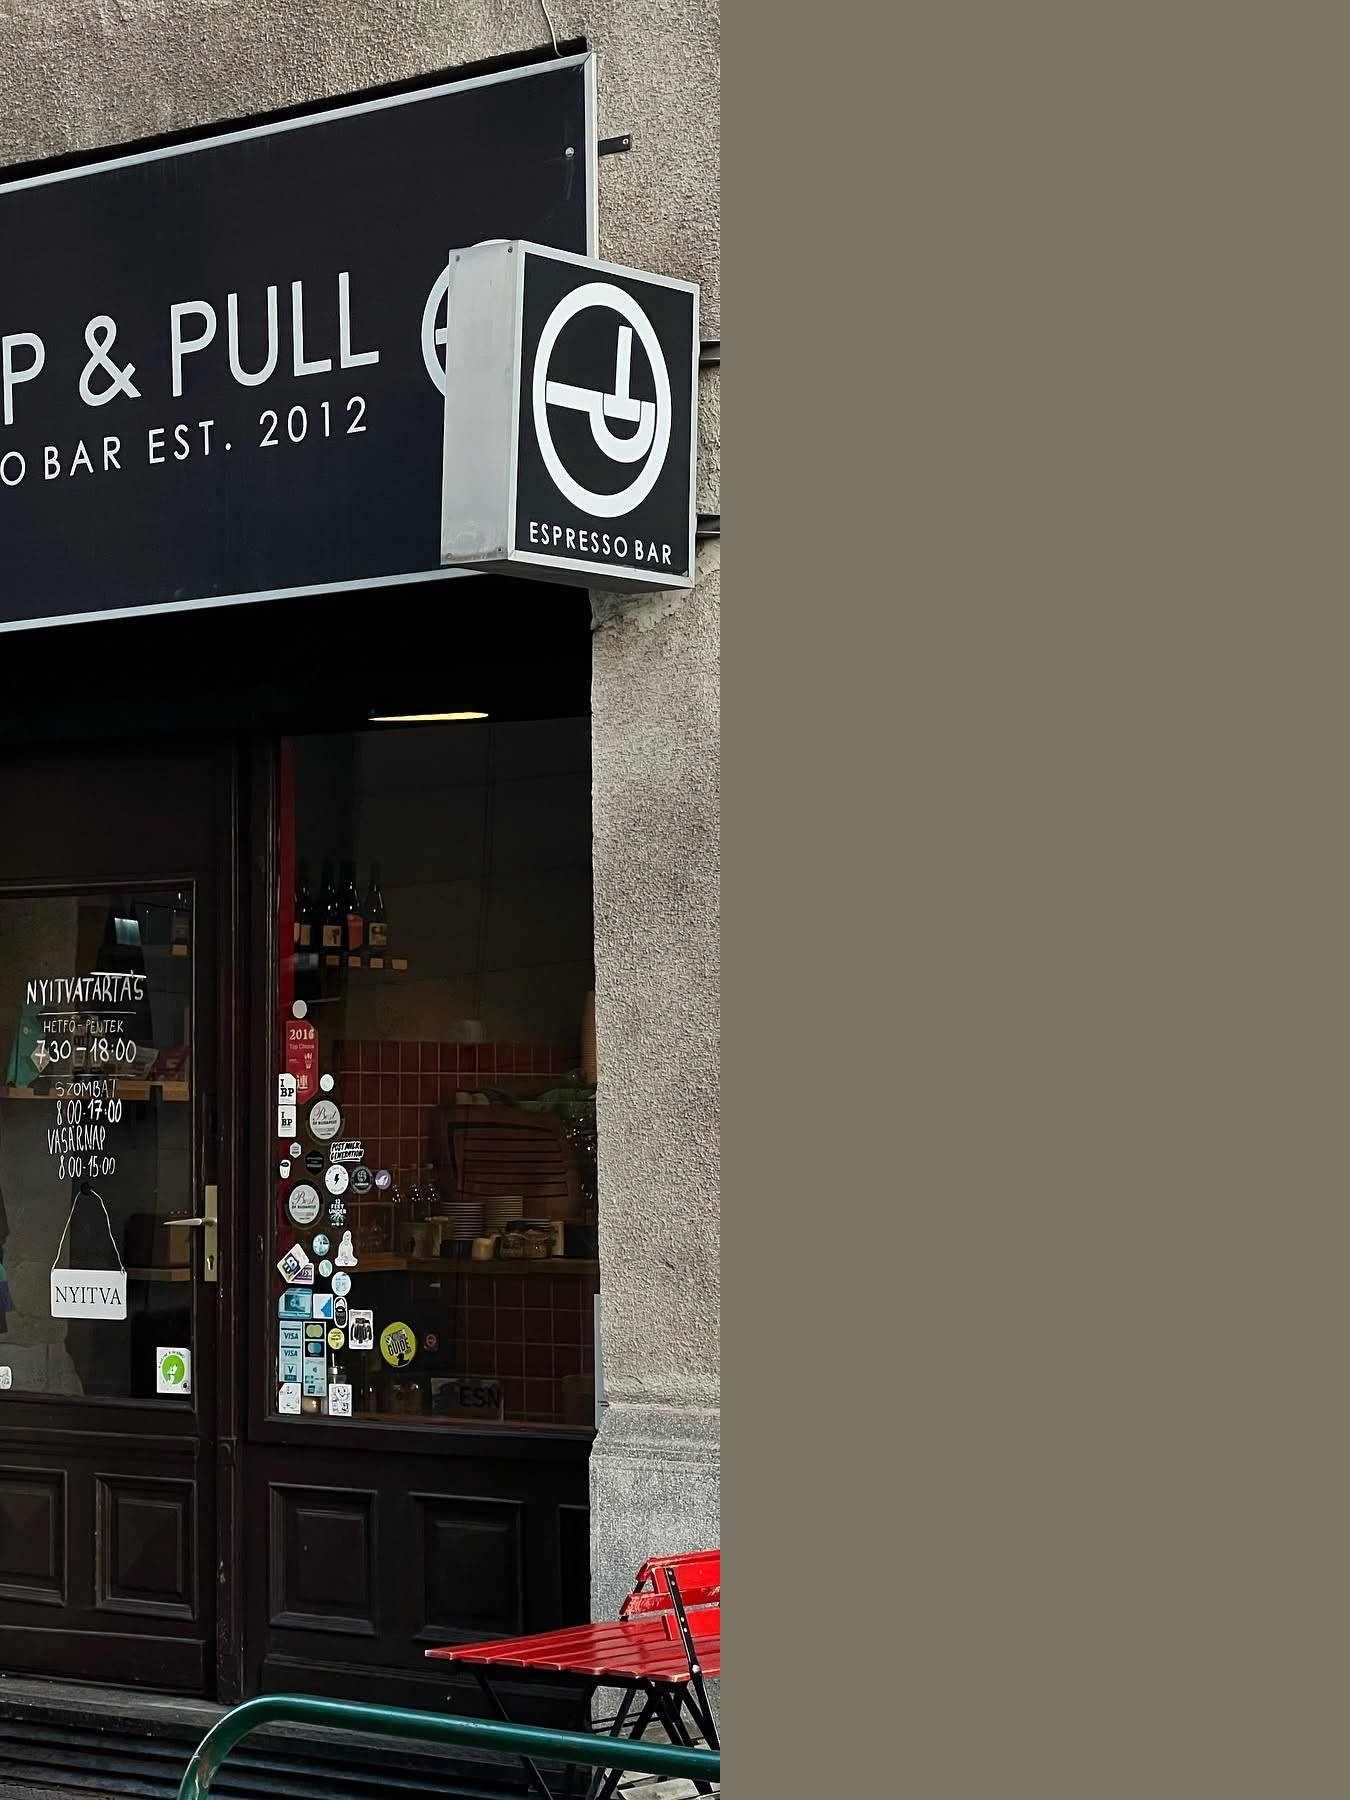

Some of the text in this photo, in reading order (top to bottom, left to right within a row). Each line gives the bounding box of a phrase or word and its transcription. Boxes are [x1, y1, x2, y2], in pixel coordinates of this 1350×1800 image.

[78, 315, 142, 406] &
[170, 271, 380, 398] PULL
[44, 436, 123, 480] BAR
[148, 419, 232, 464] EST.
[258, 395, 368, 448] 2012
[529, 522, 672, 566] ESPRESSO BAR
[289, 1029, 315, 1040] 2016
[280, 1088, 294, 1097] BP
[281, 1119, 293, 1127] BP
[55, 1286, 122, 1305] NYITVA
[388, 1338, 411, 1356] GUIDE
